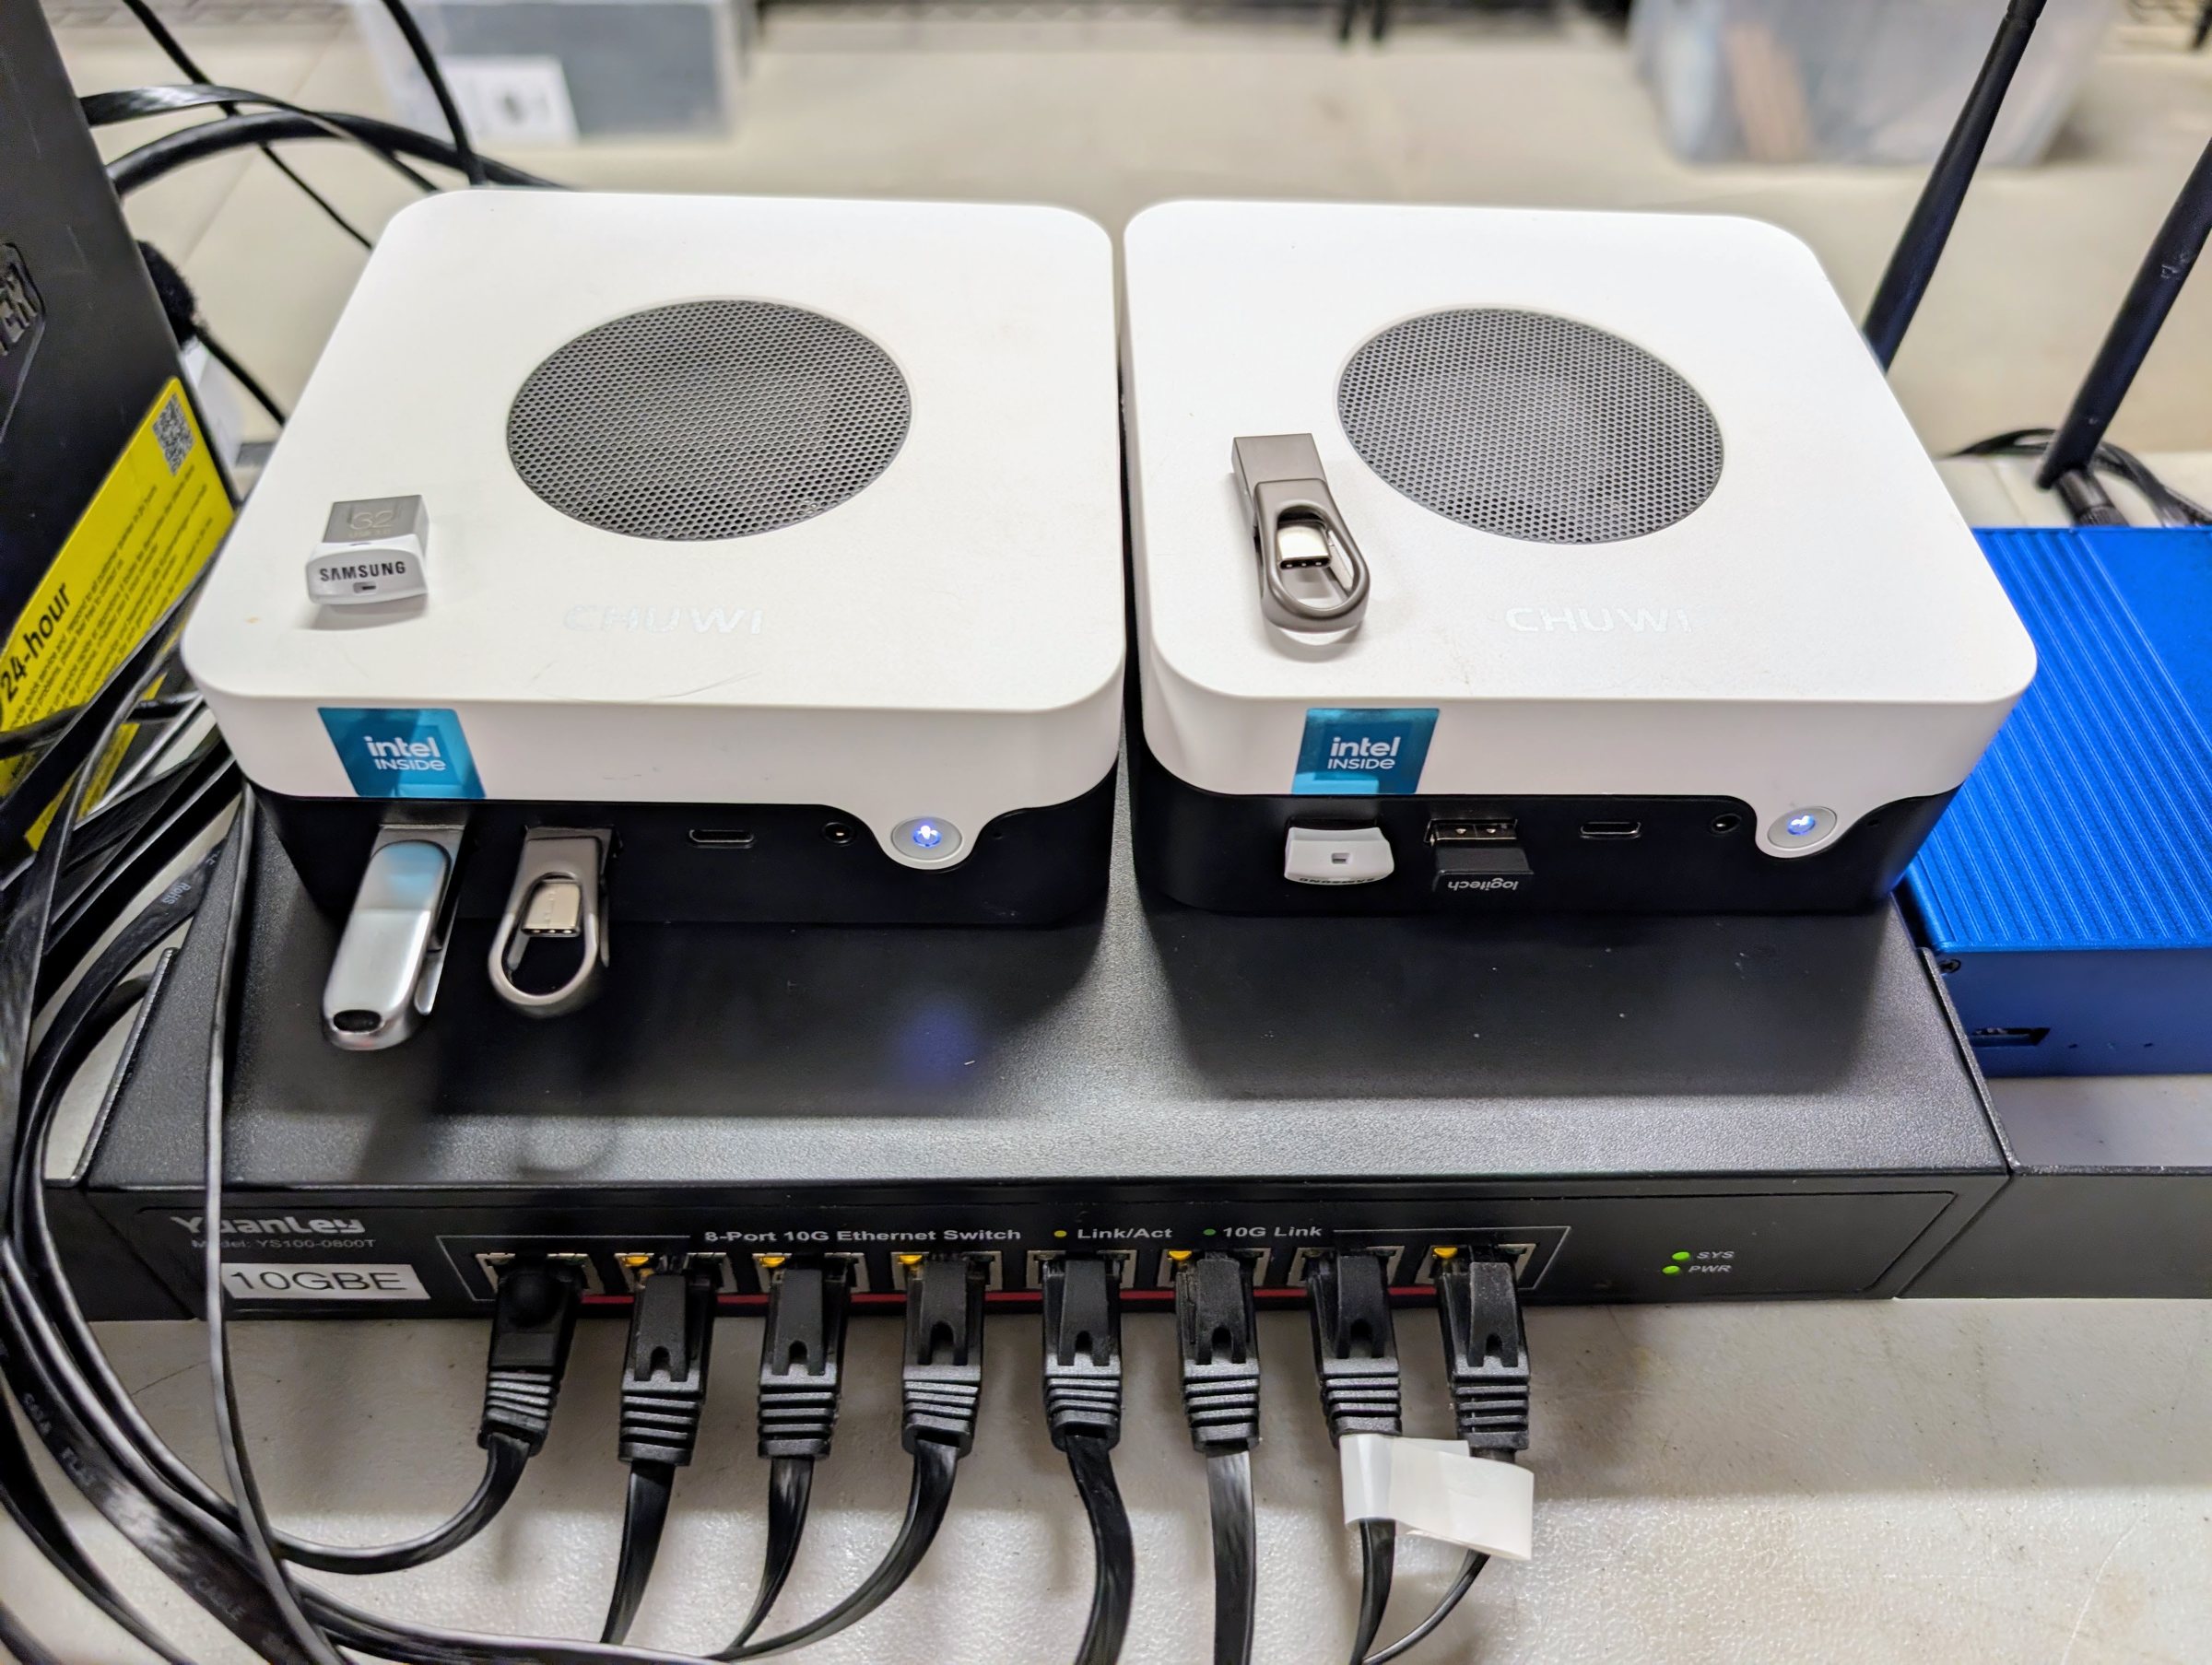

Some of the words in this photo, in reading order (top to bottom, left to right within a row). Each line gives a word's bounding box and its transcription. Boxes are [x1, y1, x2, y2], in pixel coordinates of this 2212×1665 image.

[319, 560, 406, 581] SAMSUNG
[563, 604, 764, 634] CHUWI
[1505, 607, 1692, 633] CHUWI
[364, 735, 441, 757] intel
[1330, 736, 1401, 756] intel
[161, 882, 192, 905] RoHS
[1447, 877, 1519, 891] logitech
[704, 1231, 777, 1241] 8-Port
[783, 1231, 830, 1241] 10G
[837, 1230, 935, 1241] Ethernet
[944, 1229, 1021, 1240] Switch
[1077, 1227, 1173, 1238] Link/Act
[1222, 1226, 1266, 1237] 10G
[1274, 1225, 1322, 1237] Link
[1697, 1250, 1735, 1259] SYS
[1688, 1264, 1732, 1272] PWR
[230, 1272, 407, 1291] 10GBE
